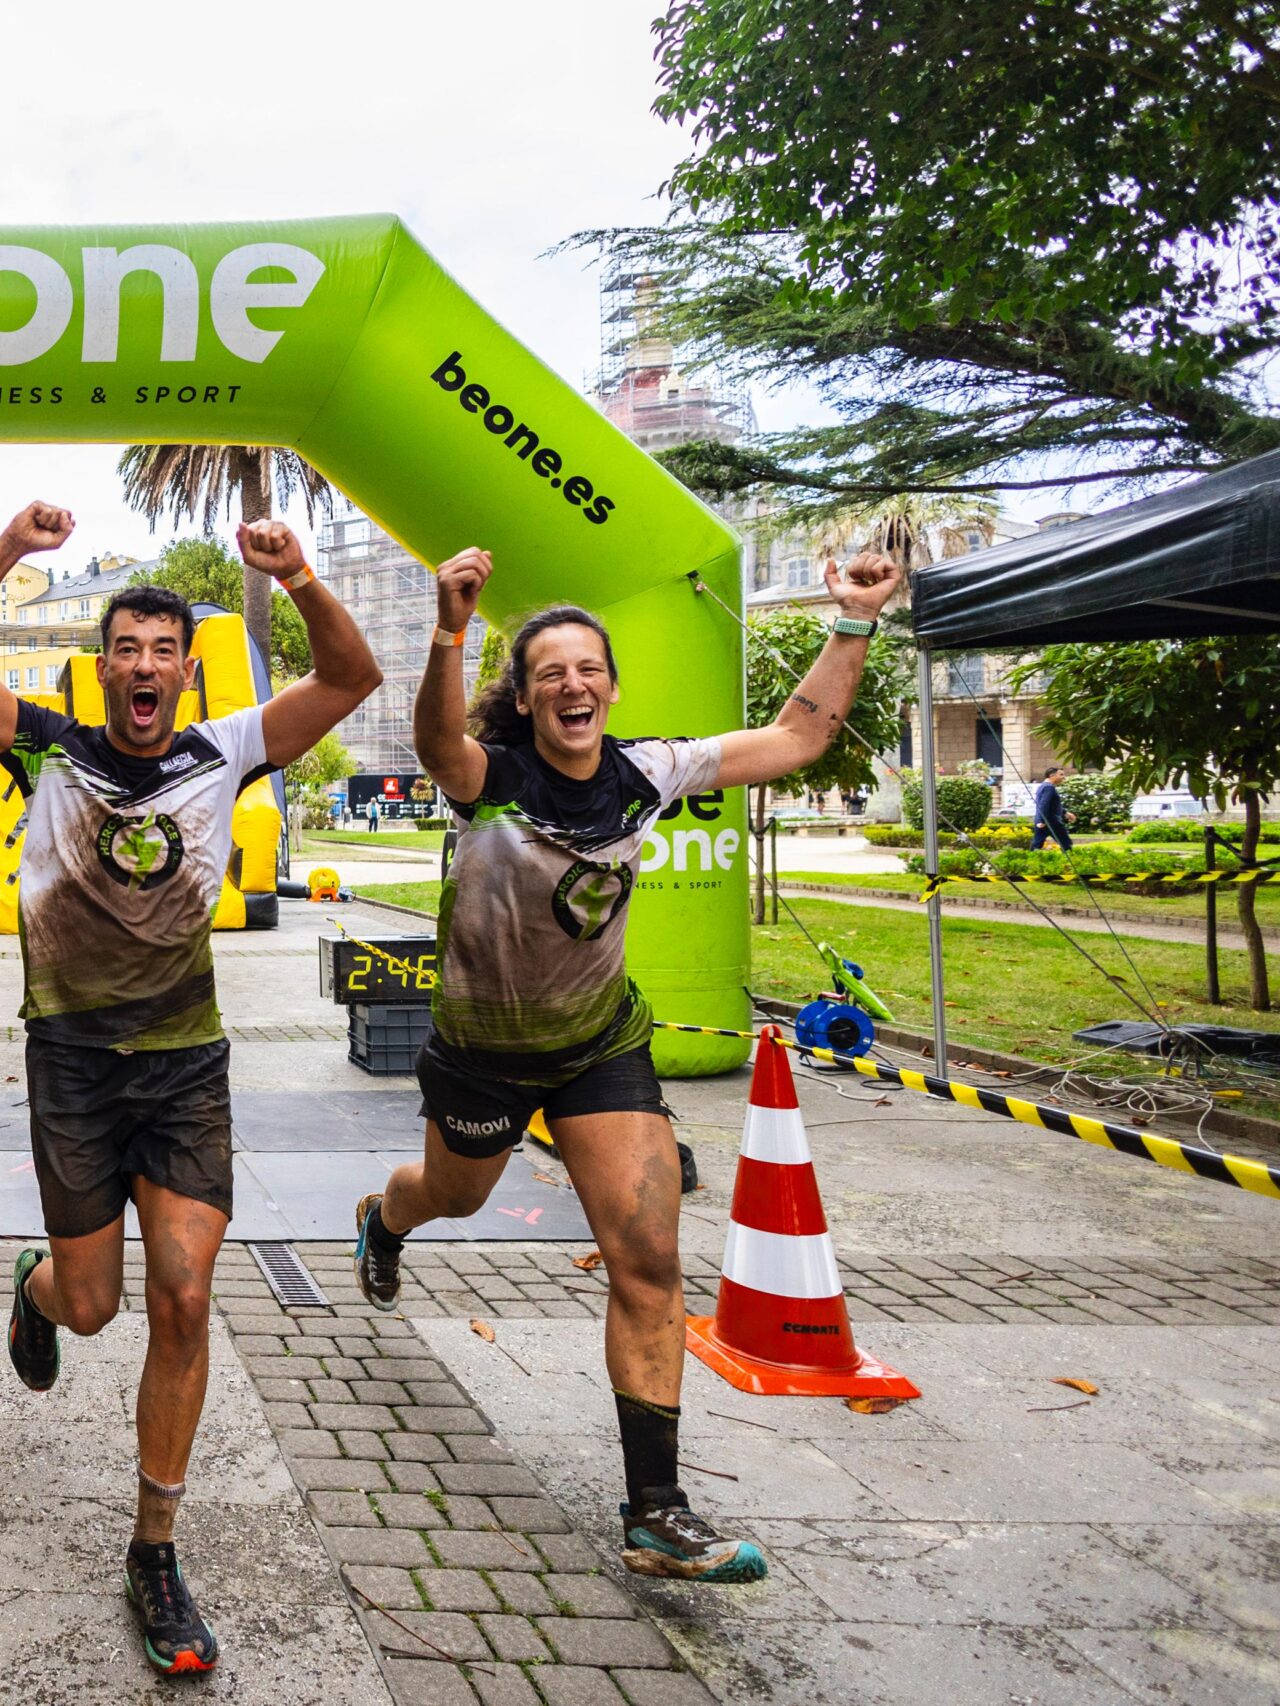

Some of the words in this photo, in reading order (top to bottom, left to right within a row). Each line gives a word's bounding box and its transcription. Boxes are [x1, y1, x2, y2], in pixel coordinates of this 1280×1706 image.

[90, 386, 107, 404] &
[134, 385, 242, 404] SPORT
[430, 350, 616, 525] beone.es
[673, 881, 680, 889] &
[689, 881, 722, 889] SPORT
[446, 1115, 511, 1136] CAMOVI
